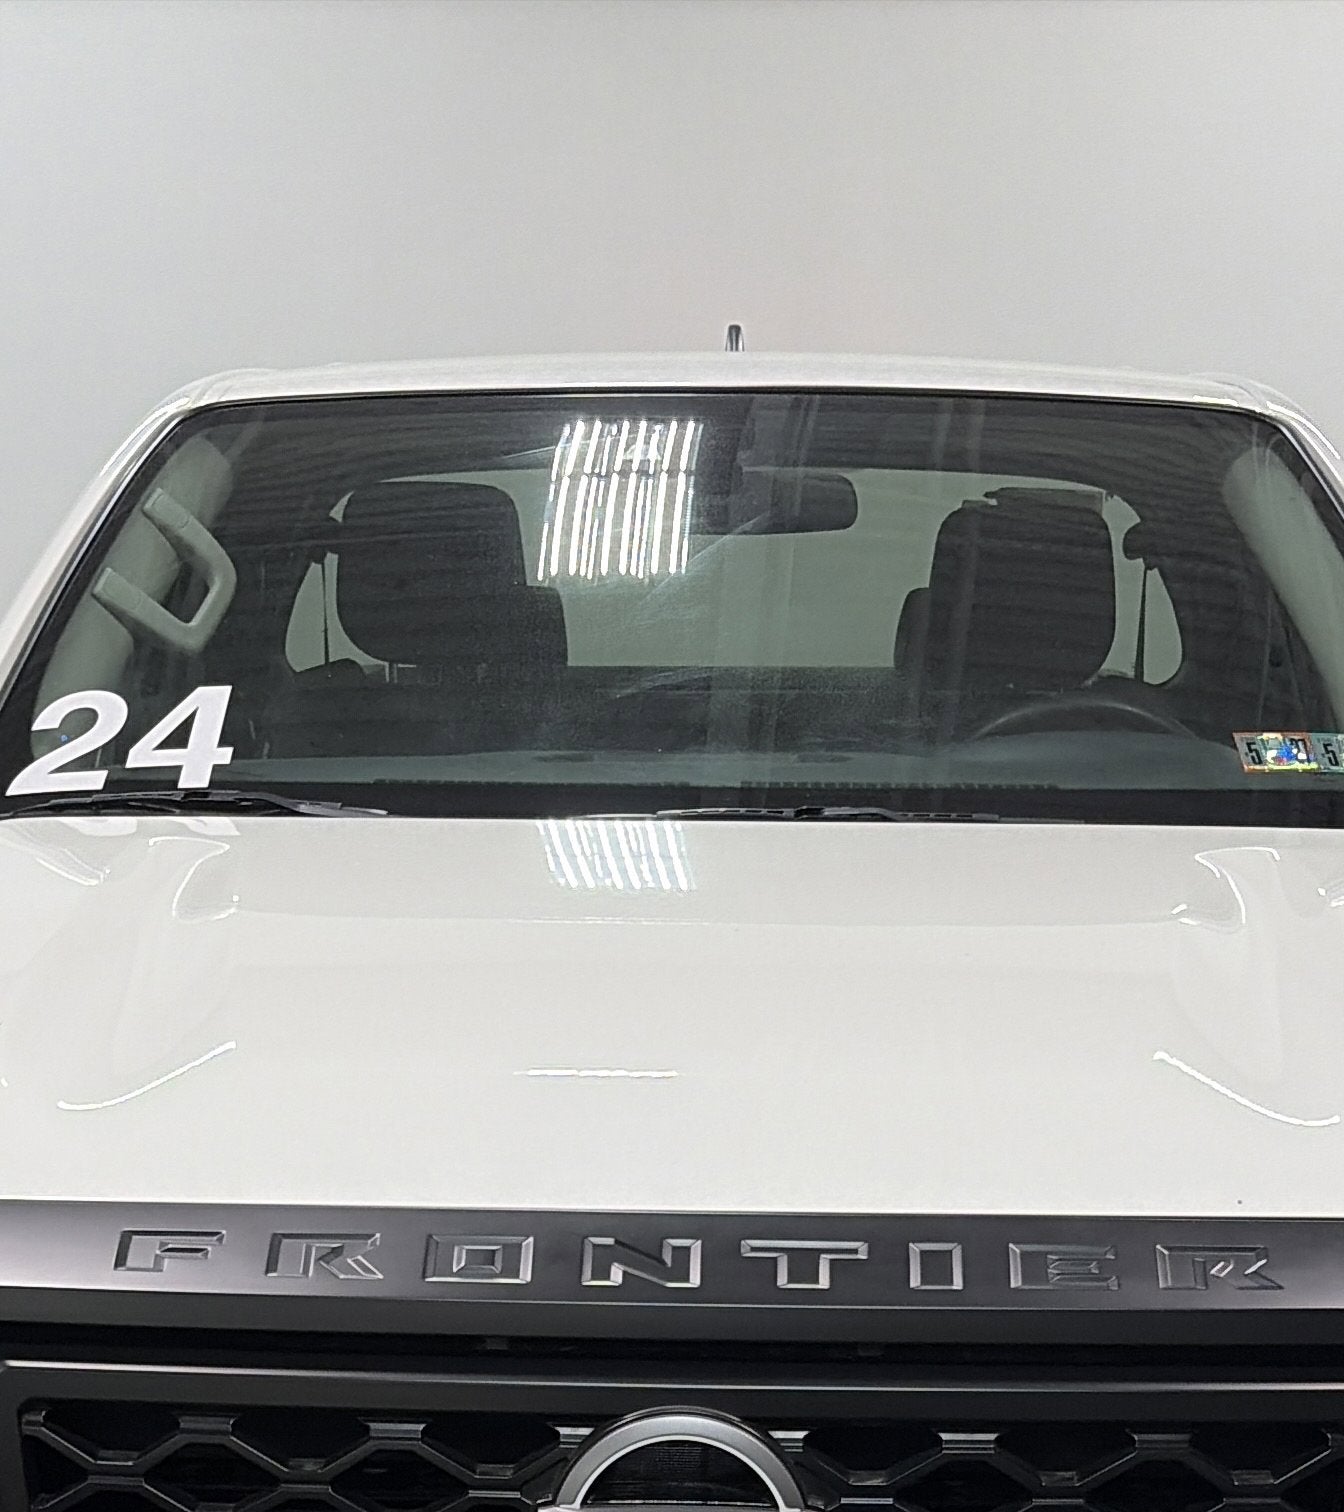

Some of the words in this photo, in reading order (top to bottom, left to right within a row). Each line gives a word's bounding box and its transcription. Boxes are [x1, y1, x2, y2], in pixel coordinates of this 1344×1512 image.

[6, 685, 234, 796] 24
[1246, 741, 1263, 765] 5
[1322, 742, 1339, 766] 5
[113, 1229, 1284, 1291] FRONTIER
